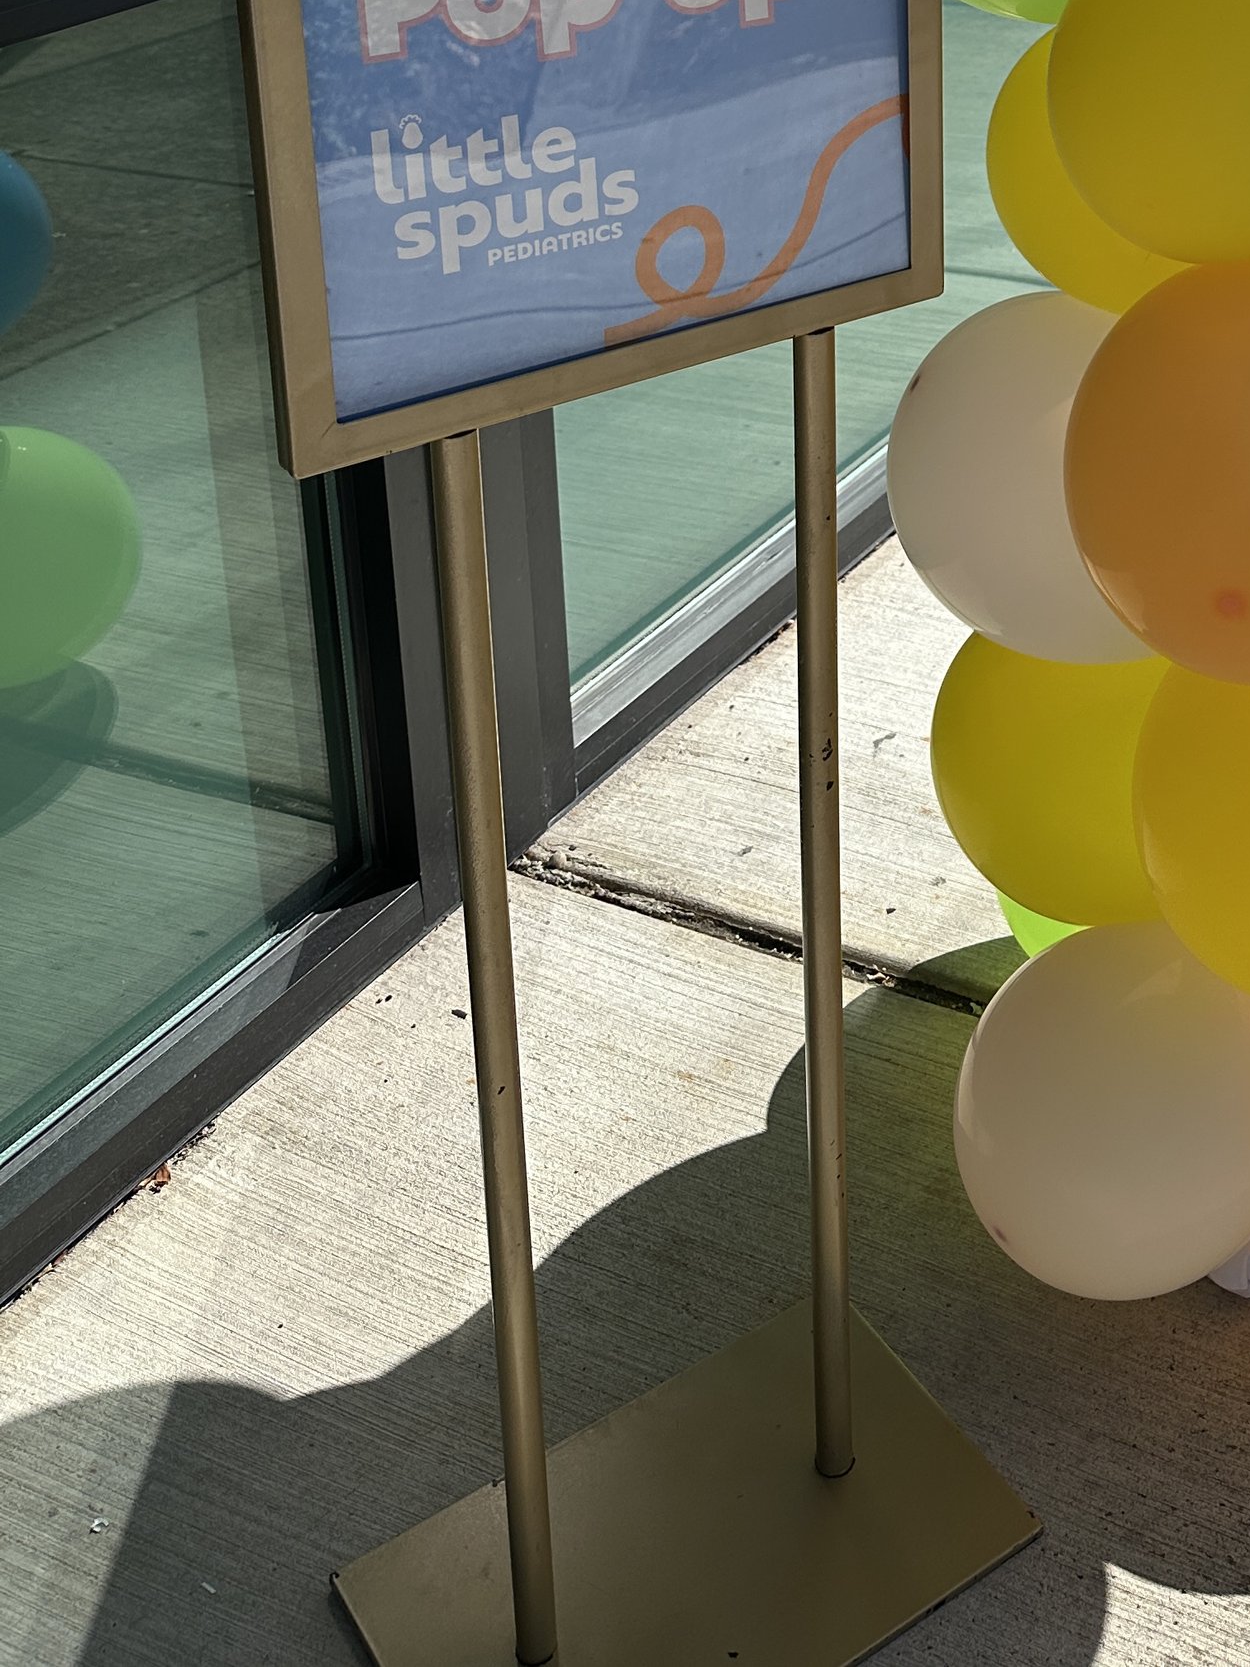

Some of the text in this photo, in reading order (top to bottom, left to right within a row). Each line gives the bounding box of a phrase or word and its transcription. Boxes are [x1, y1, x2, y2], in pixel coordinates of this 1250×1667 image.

[370, 113, 577, 205] little
[393, 159, 640, 274] spuds
[487, 221, 624, 267] PEDIATRICS
